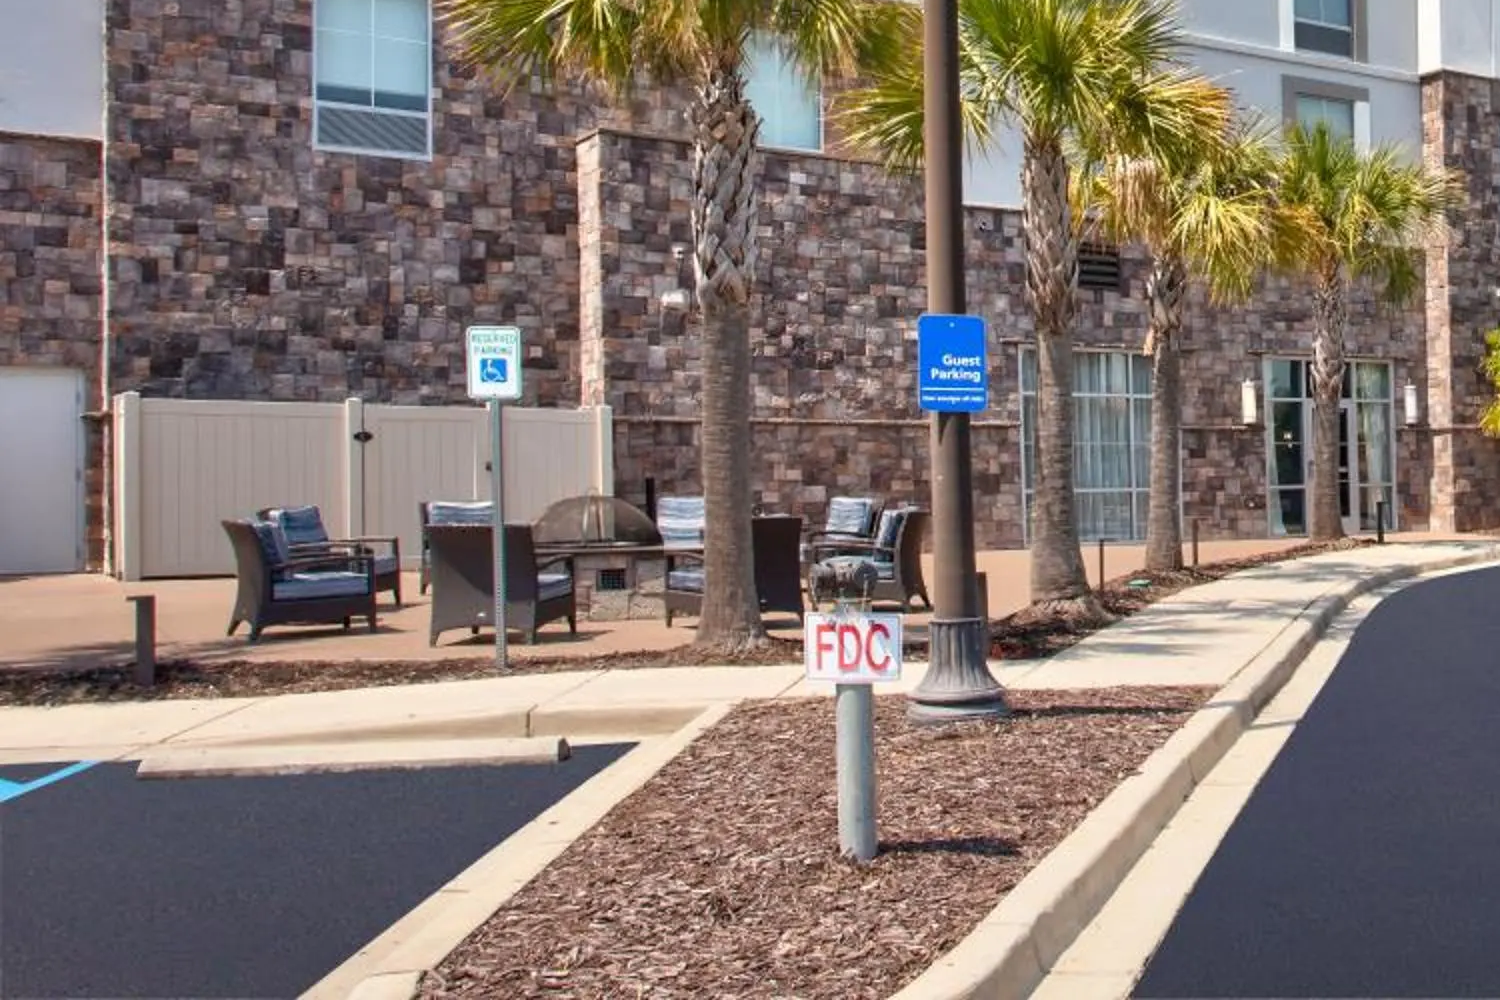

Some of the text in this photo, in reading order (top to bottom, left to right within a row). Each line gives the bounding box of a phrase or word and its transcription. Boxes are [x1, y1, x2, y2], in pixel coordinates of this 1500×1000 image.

[942, 354, 981, 366] Guest
[930, 367, 981, 383] Parking
[816, 623, 890, 672] FDC
